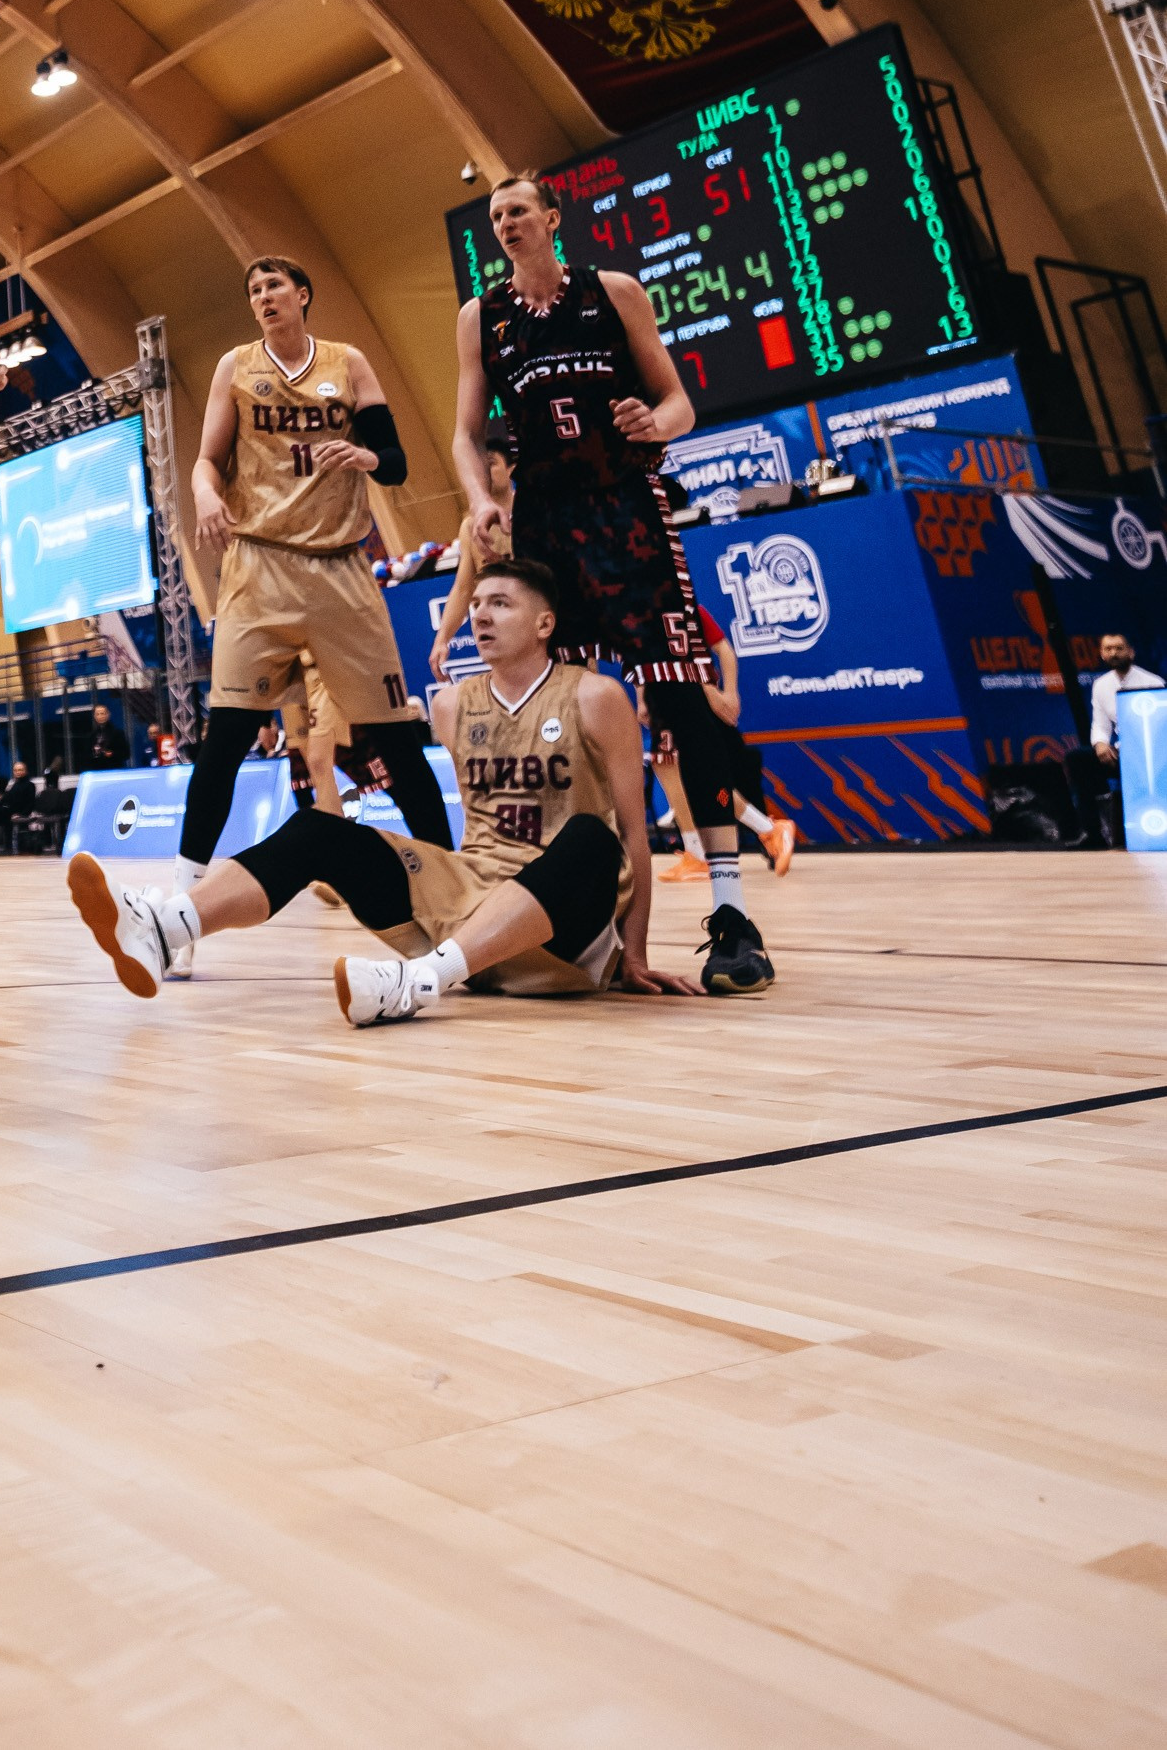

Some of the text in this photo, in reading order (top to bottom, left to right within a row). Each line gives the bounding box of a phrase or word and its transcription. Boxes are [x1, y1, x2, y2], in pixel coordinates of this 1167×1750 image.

[879, 54, 896, 81] 5
[886, 77, 903, 102] 0
[696, 87, 760, 133] ЦИВС
[892, 100, 910, 125] 0
[677, 131, 720, 160] ТУЛА
[898, 122, 915, 149] 2
[906, 146, 924, 171] 0
[703, 167, 751, 216] 51
[912, 166, 931, 193] 6
[593, 194, 617, 214] СЧЕТ
[651, 196, 672, 237] 3
[903, 190, 939, 222] 18
[591, 211, 633, 251] 41
[925, 214, 945, 240] 0
[932, 237, 952, 265] 0
[940, 263, 956, 289] 1
[947, 284, 966, 312] 6
[938, 311, 974, 342] 13
[683, 351, 707, 389] 7
[252, 402, 344, 435] ЦИВС
[550, 397, 582, 440] 5
[290, 443, 313, 477] 11
[677, 461, 736, 491] ИНАЛ
[752, 598, 821, 627] ТВЕРЬ
[662, 611, 690, 657] 5
[383, 674, 407, 709] 11
[768, 666, 924, 697] #СемьяБКТверь
[466, 754, 572, 795] ЦИВС
